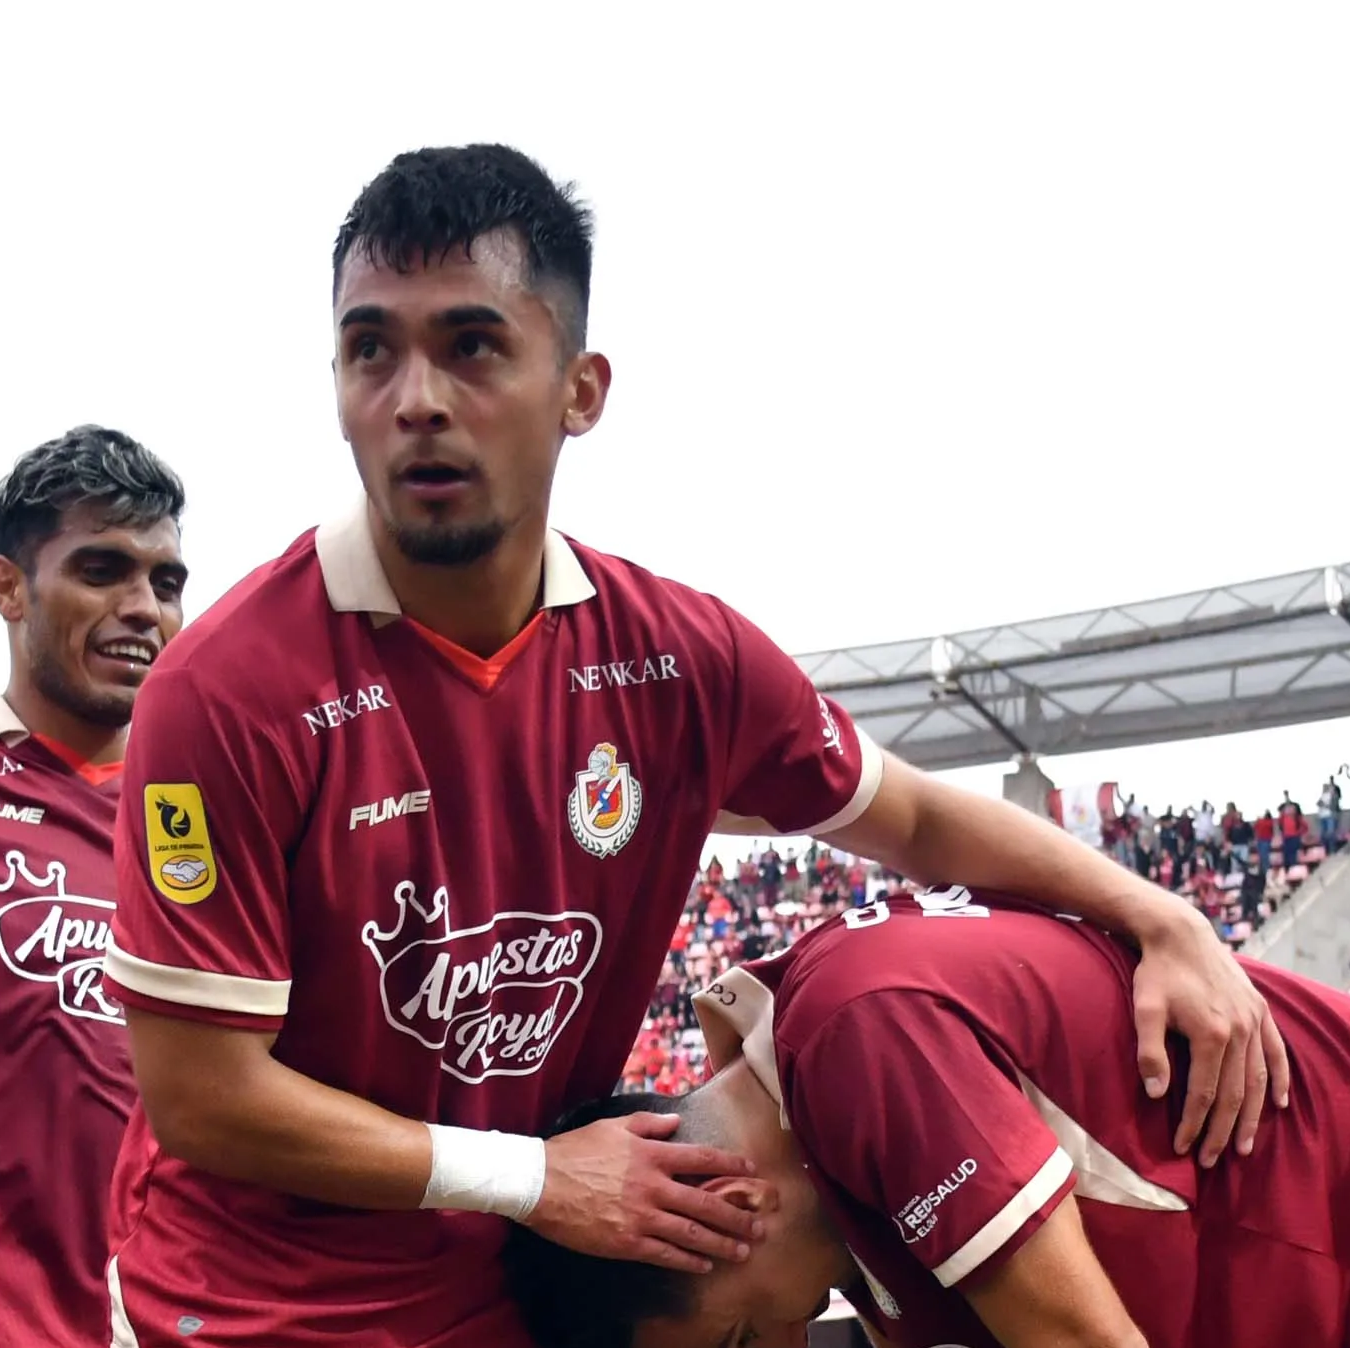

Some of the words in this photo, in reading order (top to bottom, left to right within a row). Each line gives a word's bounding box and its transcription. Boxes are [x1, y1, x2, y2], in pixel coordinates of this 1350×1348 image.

[567, 654, 681, 692] NEWKAR
[349, 789, 431, 831] FIUME
[904, 1158, 978, 1229] REDSALUD
